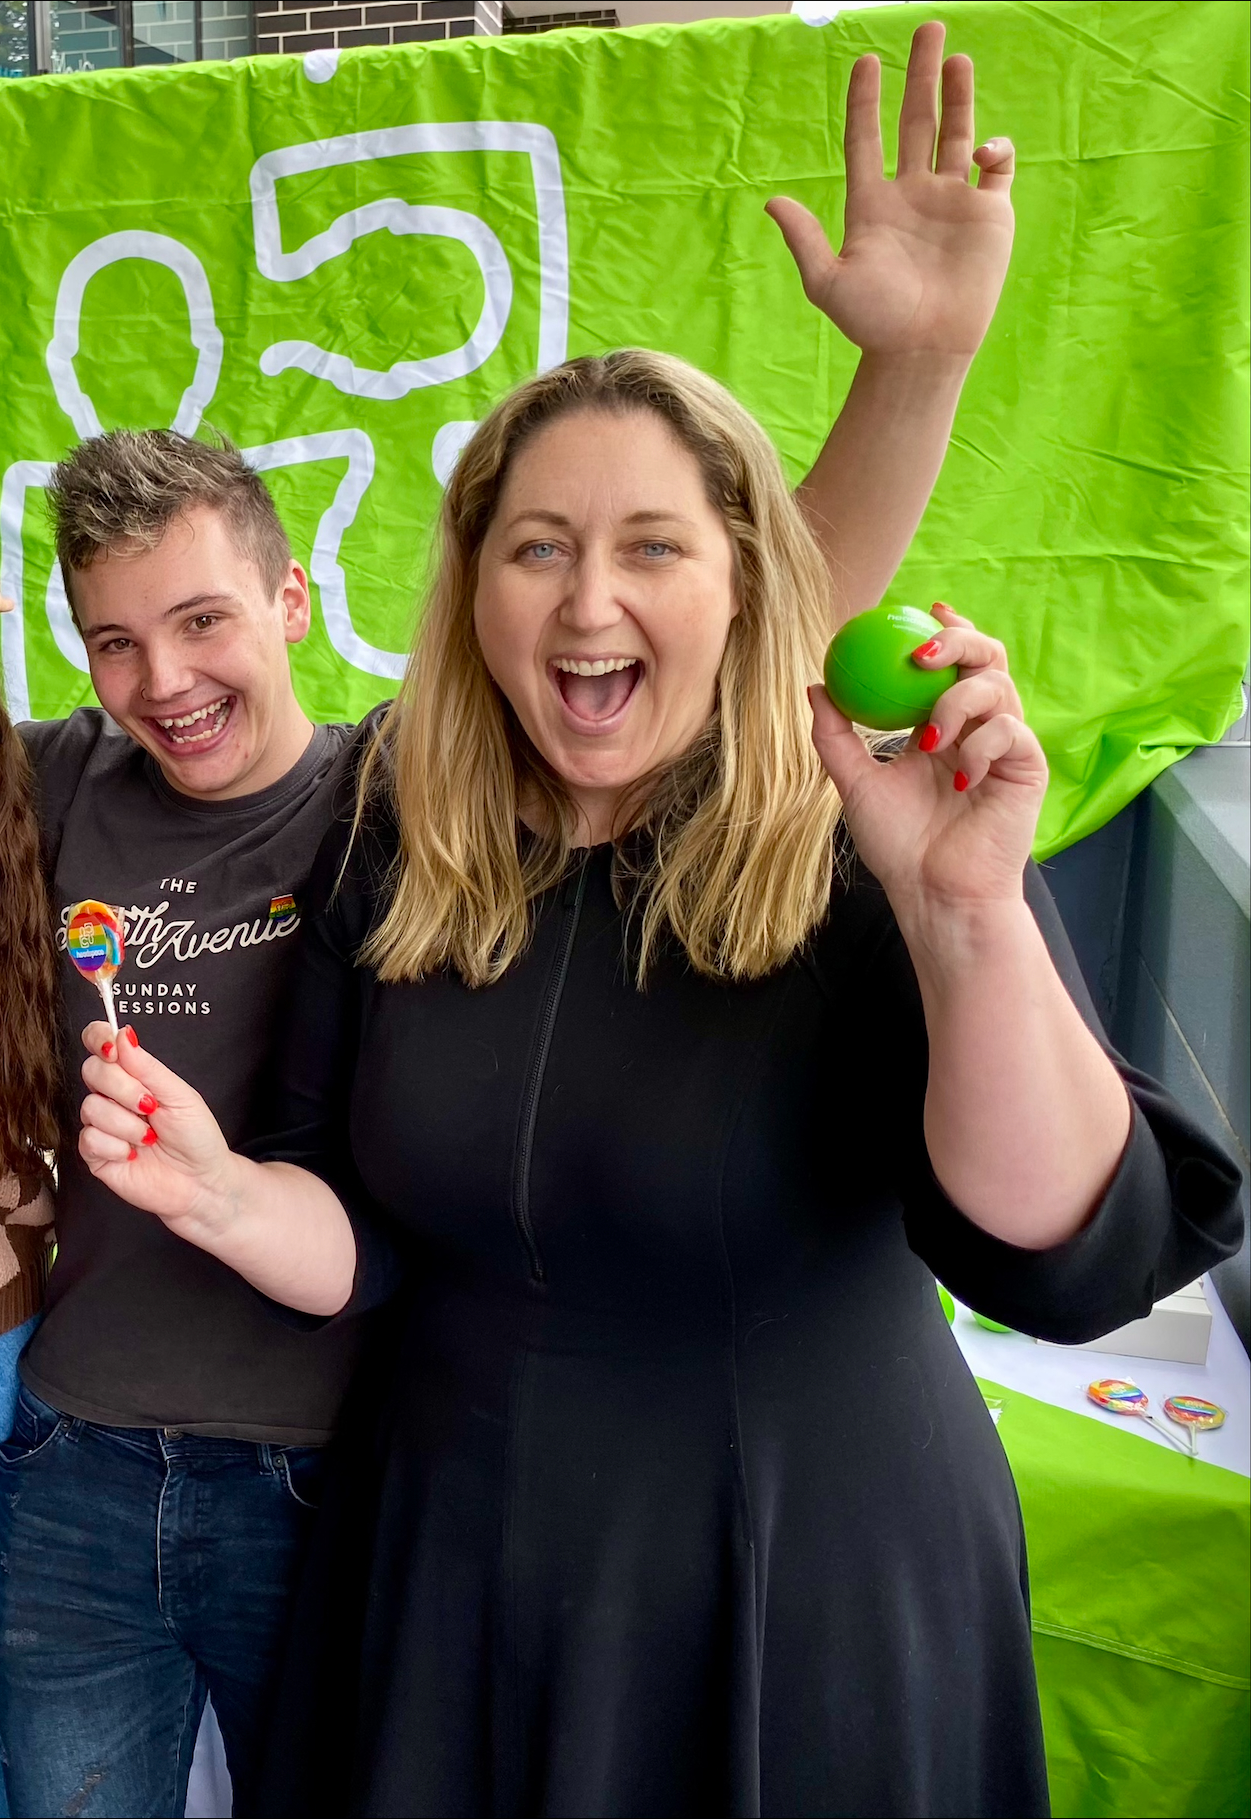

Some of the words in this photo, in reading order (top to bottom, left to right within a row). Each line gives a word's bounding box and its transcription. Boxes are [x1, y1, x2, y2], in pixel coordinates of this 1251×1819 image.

[159, 877, 198, 894] THE
[136, 916, 301, 969] Avenue
[112, 982, 198, 998] SUNDAY
[117, 1000, 212, 1016] ESSIONS
